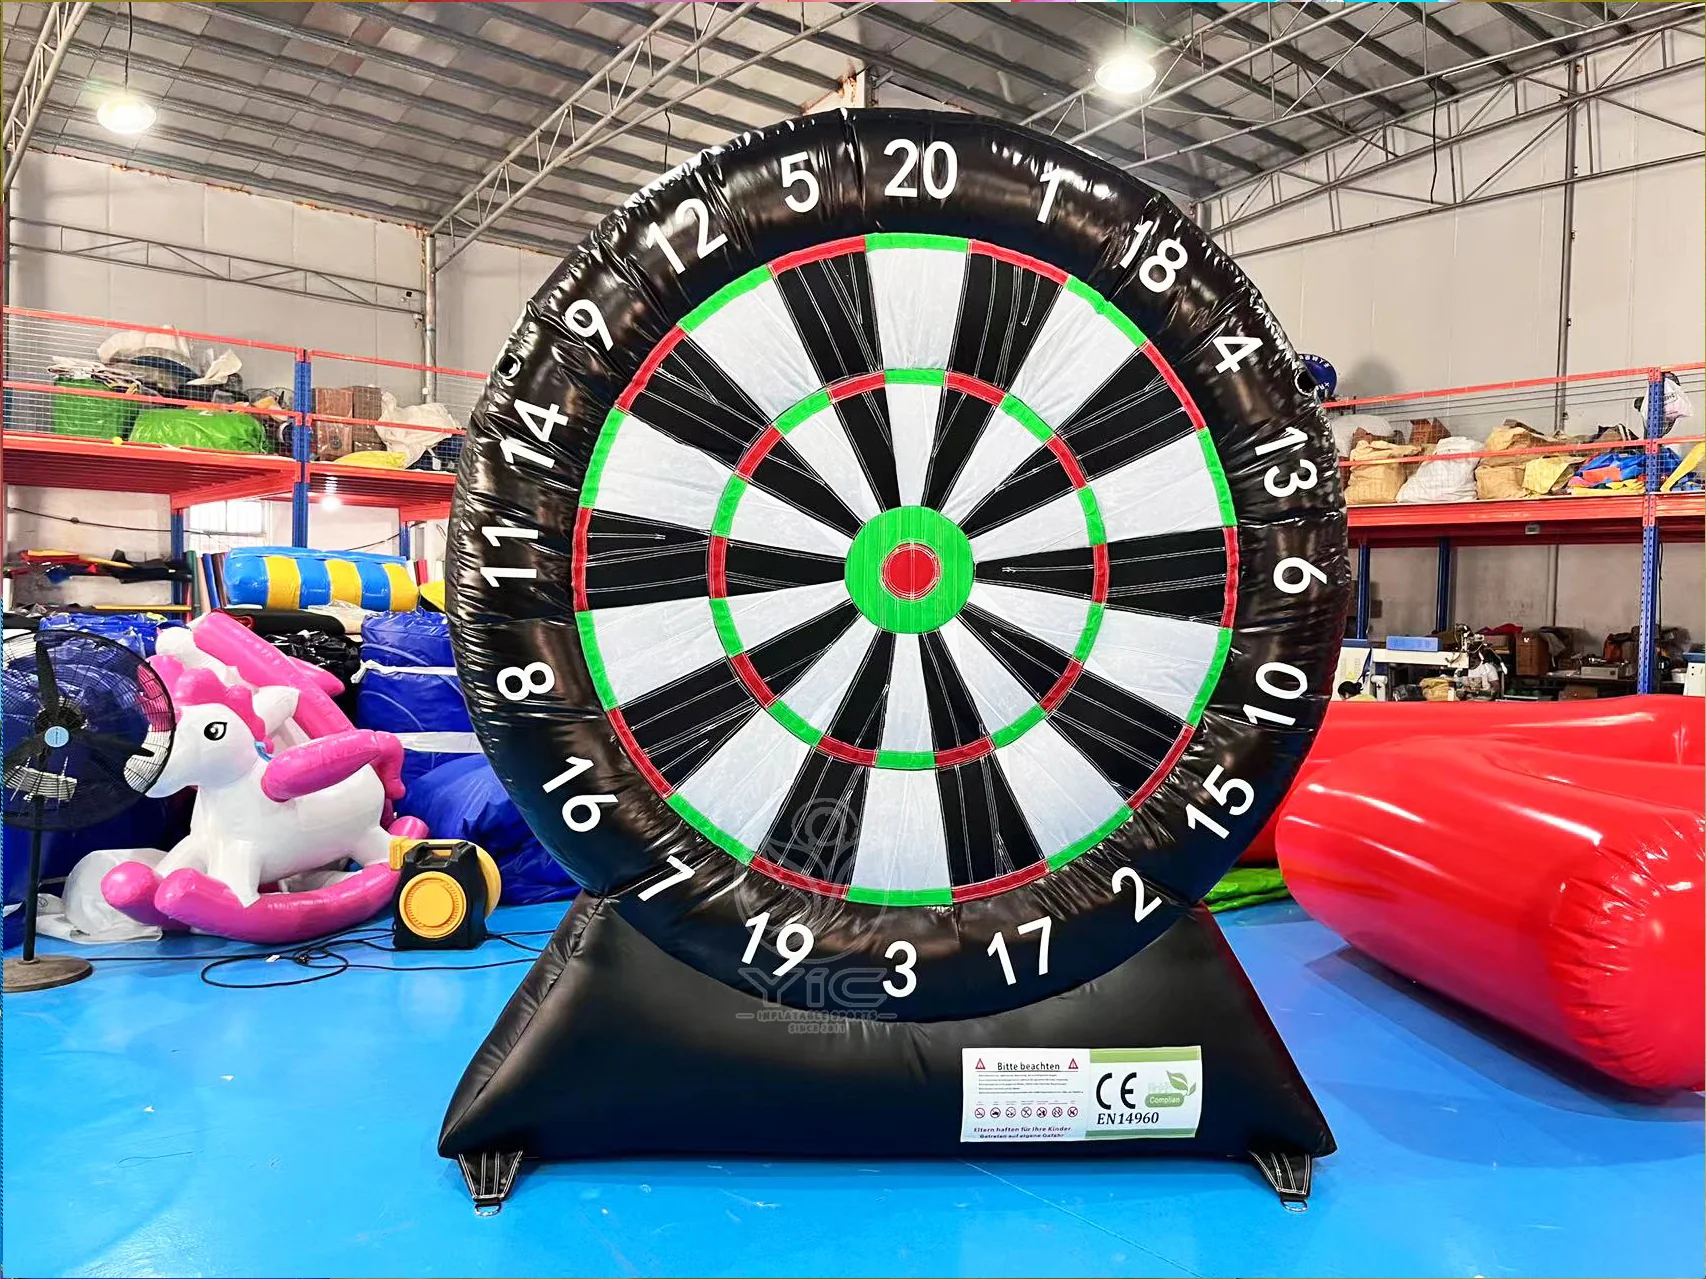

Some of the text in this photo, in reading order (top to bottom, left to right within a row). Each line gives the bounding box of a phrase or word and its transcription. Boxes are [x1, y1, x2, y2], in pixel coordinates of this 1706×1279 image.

[780, 151, 820, 213] 5
[883, 138, 958, 199] 20
[1036, 168, 1062, 224] 1
[645, 197, 728, 275] 12
[1119, 220, 1188, 293] 18
[561, 299, 614, 351] 9
[1212, 335, 1264, 374] 4
[500, 399, 569, 468] 14
[1254, 427, 1318, 498] 13
[480, 526, 539, 588] 11
[496, 661, 555, 701] 8
[1242, 662, 1308, 726] 10
[542, 756, 619, 832] 16
[1185, 764, 1255, 839] 15
[637, 855, 696, 902] 7
[1111, 866, 1163, 923] 2
[741, 911, 815, 977] 19
[882, 940, 917, 998] 3
[987, 915, 1052, 985] 17
[997, 1061, 1060, 1070] Bitte beachten
[1095, 1072, 1137, 1110] CE
